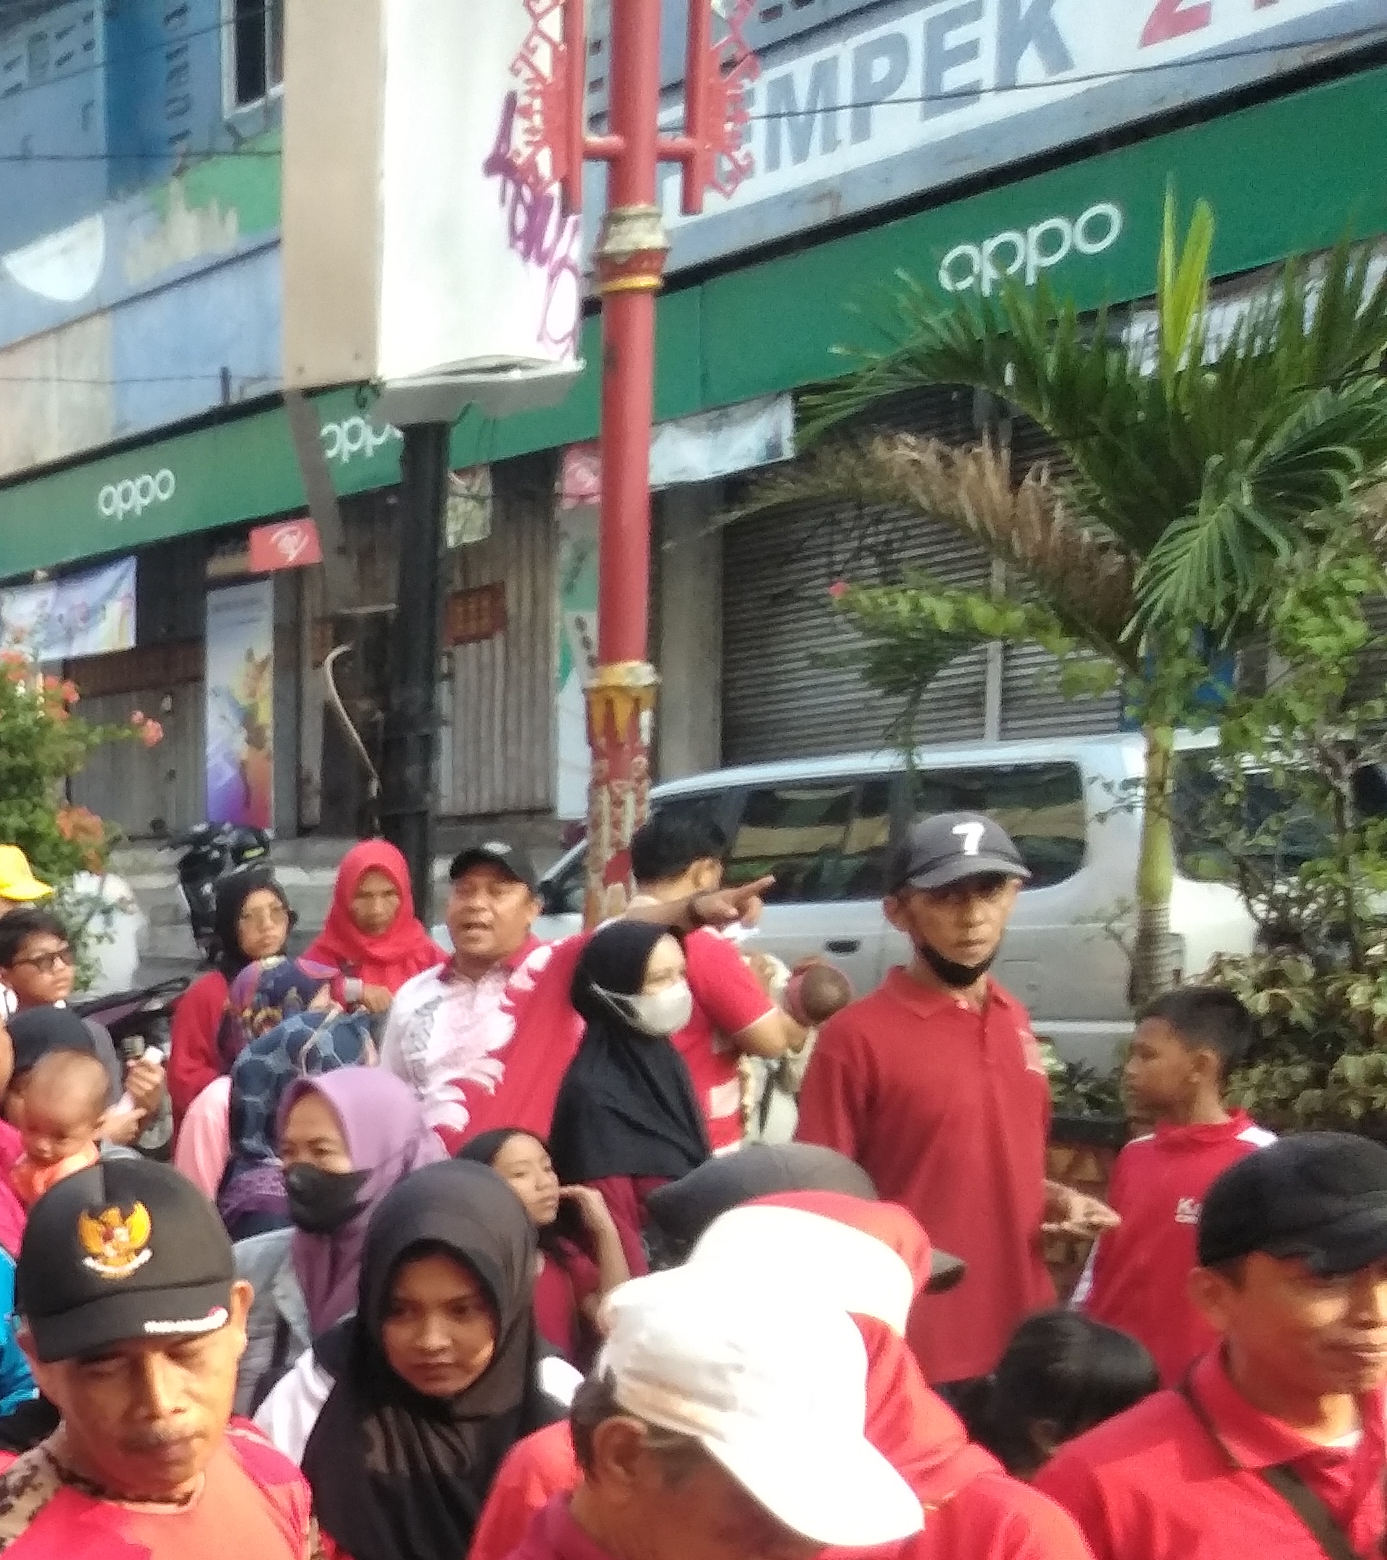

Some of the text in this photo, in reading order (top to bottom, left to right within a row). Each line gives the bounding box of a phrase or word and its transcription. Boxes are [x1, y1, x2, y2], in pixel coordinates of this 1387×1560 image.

[741, 0, 1075, 174] MPEK
[938, 202, 1123, 297] oppo
[320, 415, 404, 463] opp
[97, 467, 176, 521] oppo
[952, 821, 985, 856] 7
